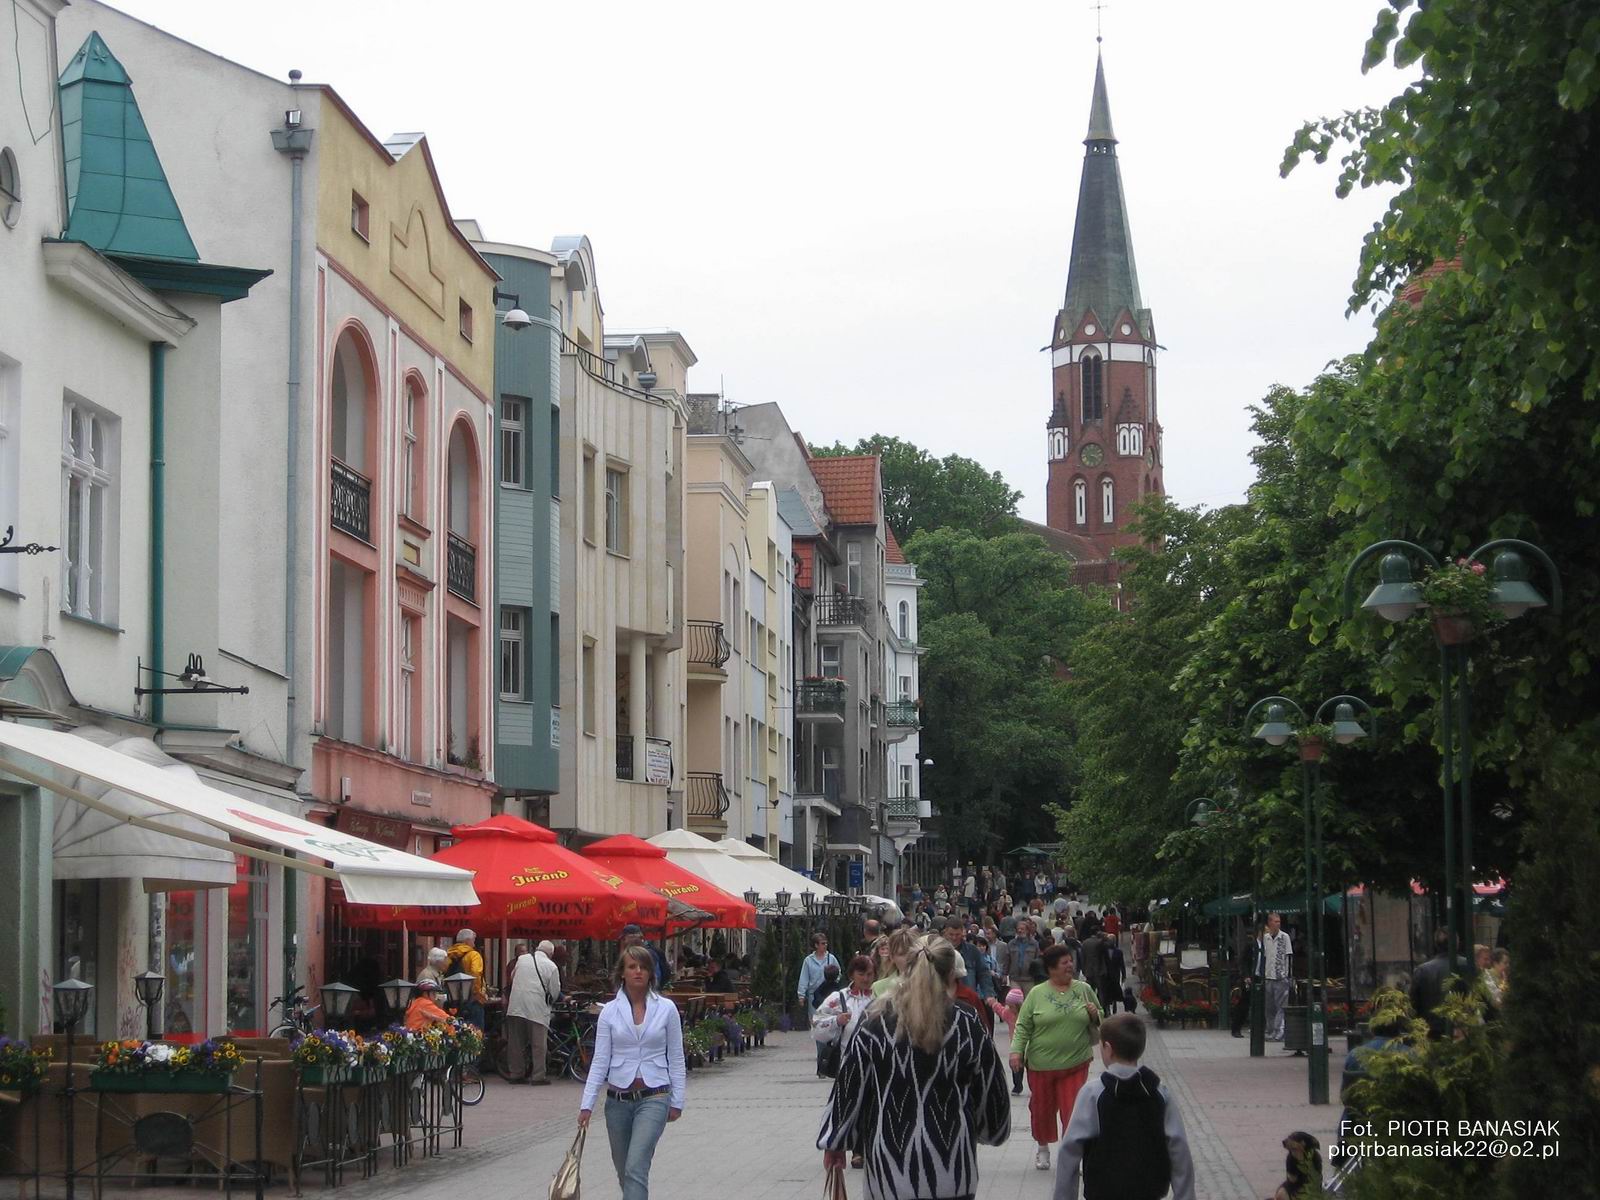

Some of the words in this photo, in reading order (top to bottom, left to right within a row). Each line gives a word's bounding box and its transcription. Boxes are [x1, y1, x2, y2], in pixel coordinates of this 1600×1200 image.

[511, 870, 570, 887] Jurand
[660, 883, 700, 898] Jurand
[538, 901, 595, 916] MOCNE
